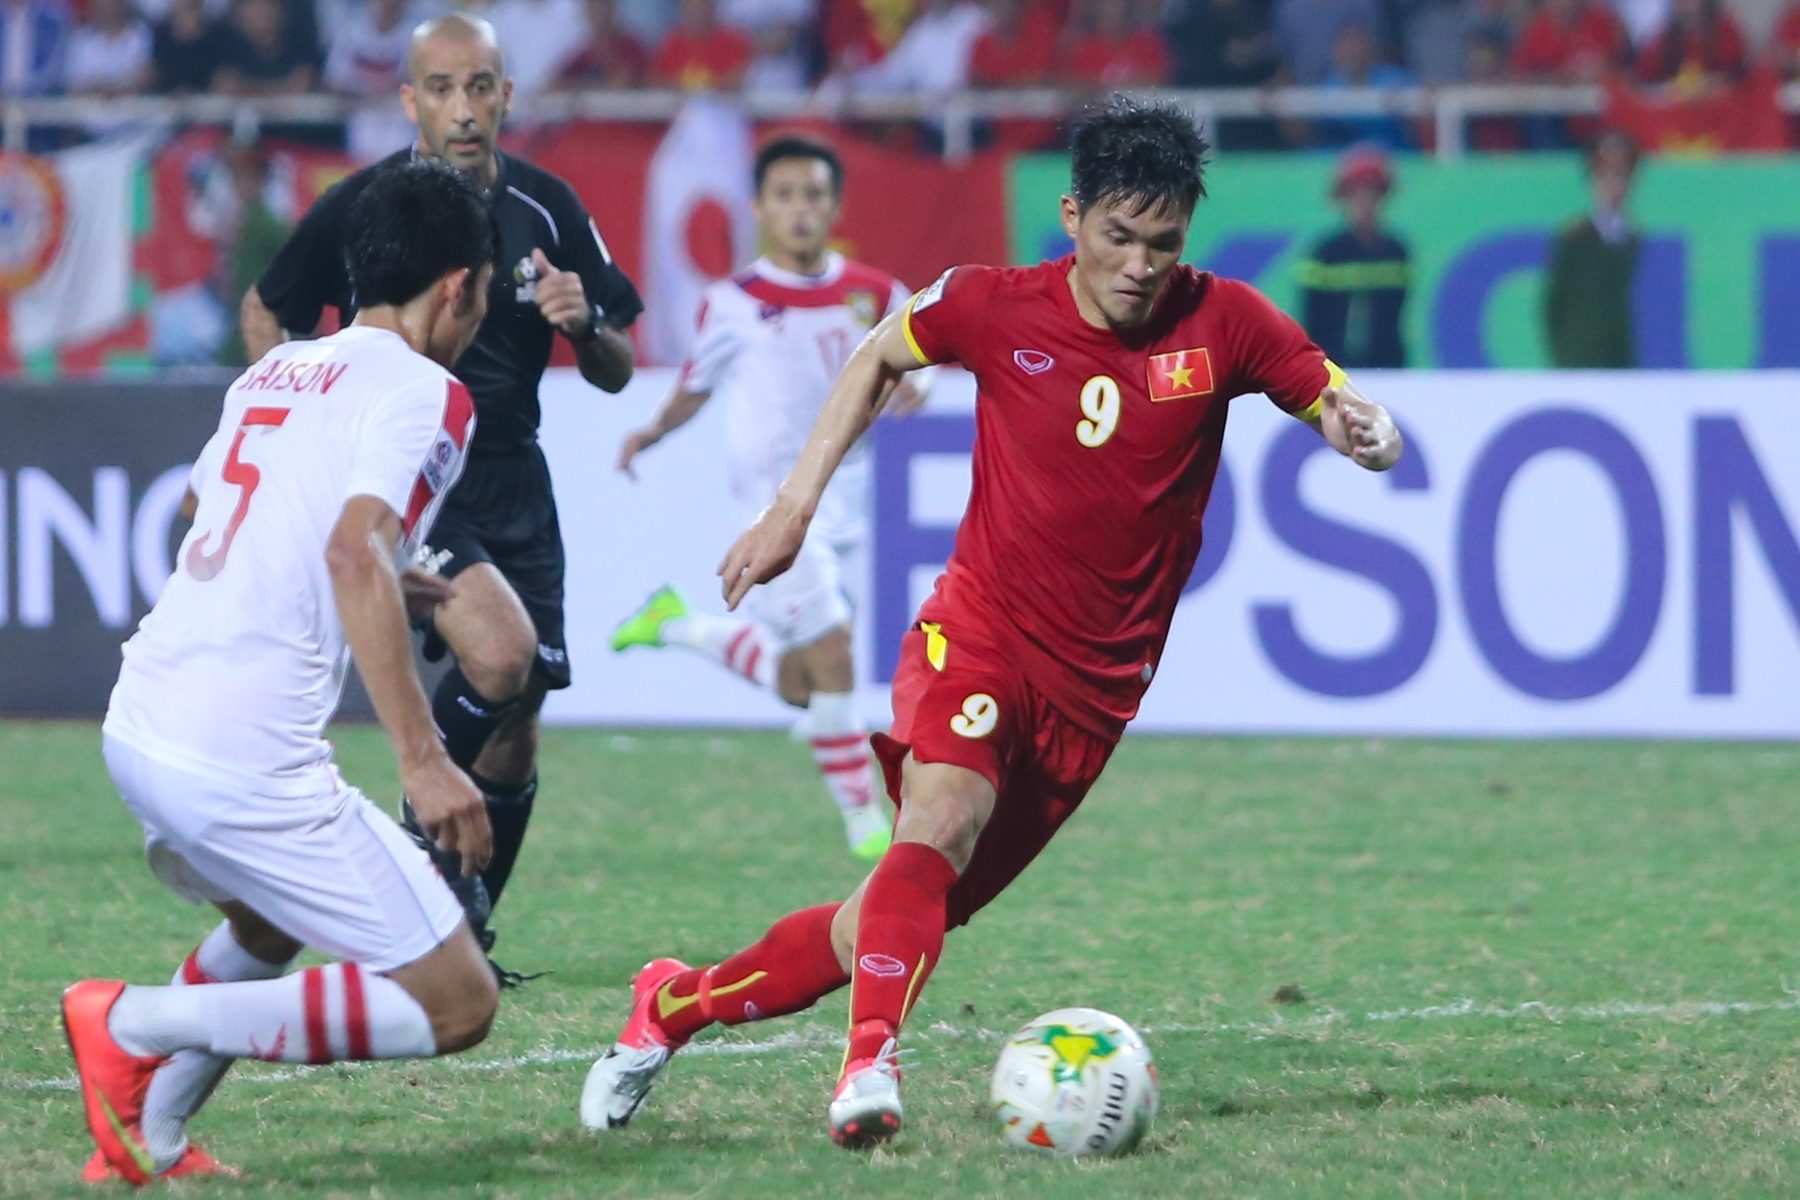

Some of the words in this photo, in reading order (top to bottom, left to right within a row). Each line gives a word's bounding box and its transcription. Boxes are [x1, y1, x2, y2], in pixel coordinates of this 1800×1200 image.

[1076, 375, 1121, 448] 9
[186, 407, 292, 581] 5
[950, 693, 999, 738] 9
